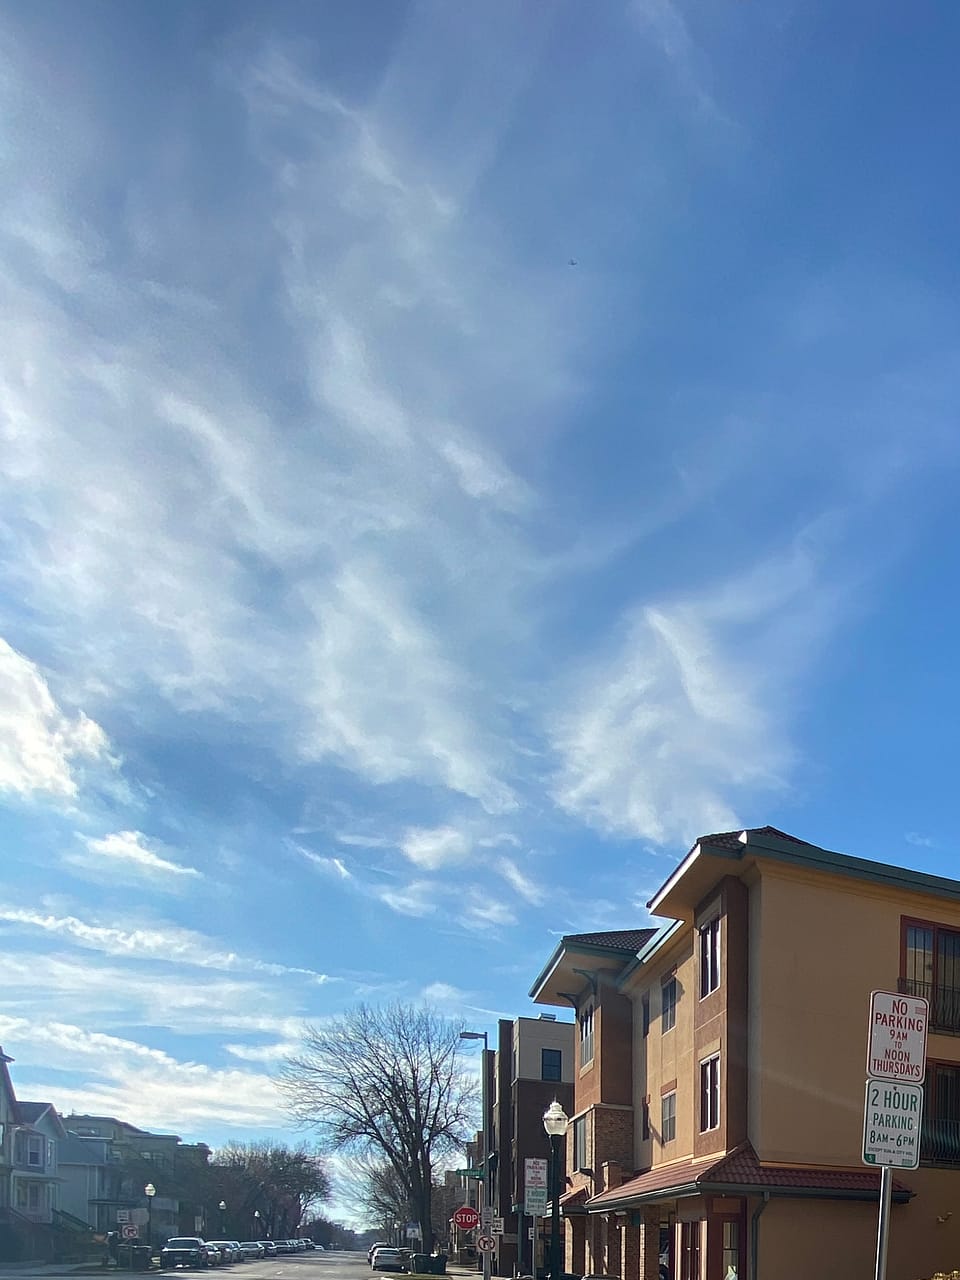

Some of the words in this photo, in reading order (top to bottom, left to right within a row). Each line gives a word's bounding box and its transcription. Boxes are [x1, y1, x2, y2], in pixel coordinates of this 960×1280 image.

[892, 1000, 908, 1016] NO
[875, 1012, 923, 1032] PARKING
[894, 1041, 903, 1050] TO
[884, 1049, 910, 1063] NOON
[873, 1058, 921, 1078] THURSDAYS
[871, 1088, 880, 1107] 2
[883, 1090, 918, 1112] HOUR
[872, 1112, 914, 1131] PARKING
[456, 1214, 478, 1223] STOP
